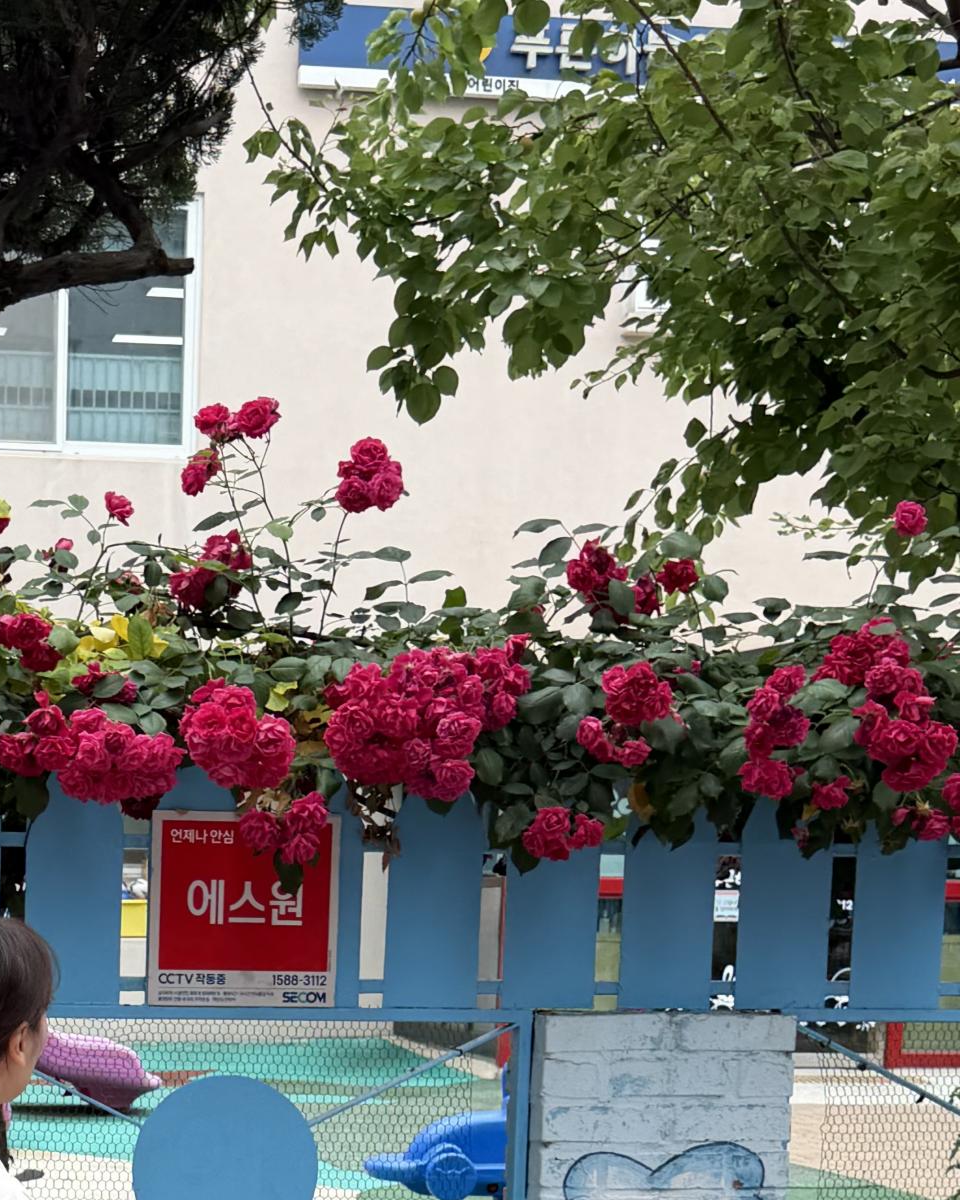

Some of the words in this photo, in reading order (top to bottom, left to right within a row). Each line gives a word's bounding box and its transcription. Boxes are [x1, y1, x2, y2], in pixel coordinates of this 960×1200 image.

[170, 828, 208, 844] 언제나
[210, 829, 235, 845] 안심
[187, 879, 303, 926] 에스원
[158, 973, 193, 985] CCTV
[195, 973, 226, 985] 작동중
[272, 975, 327, 986] 1588-3112
[282, 991, 326, 1004] SECOM
